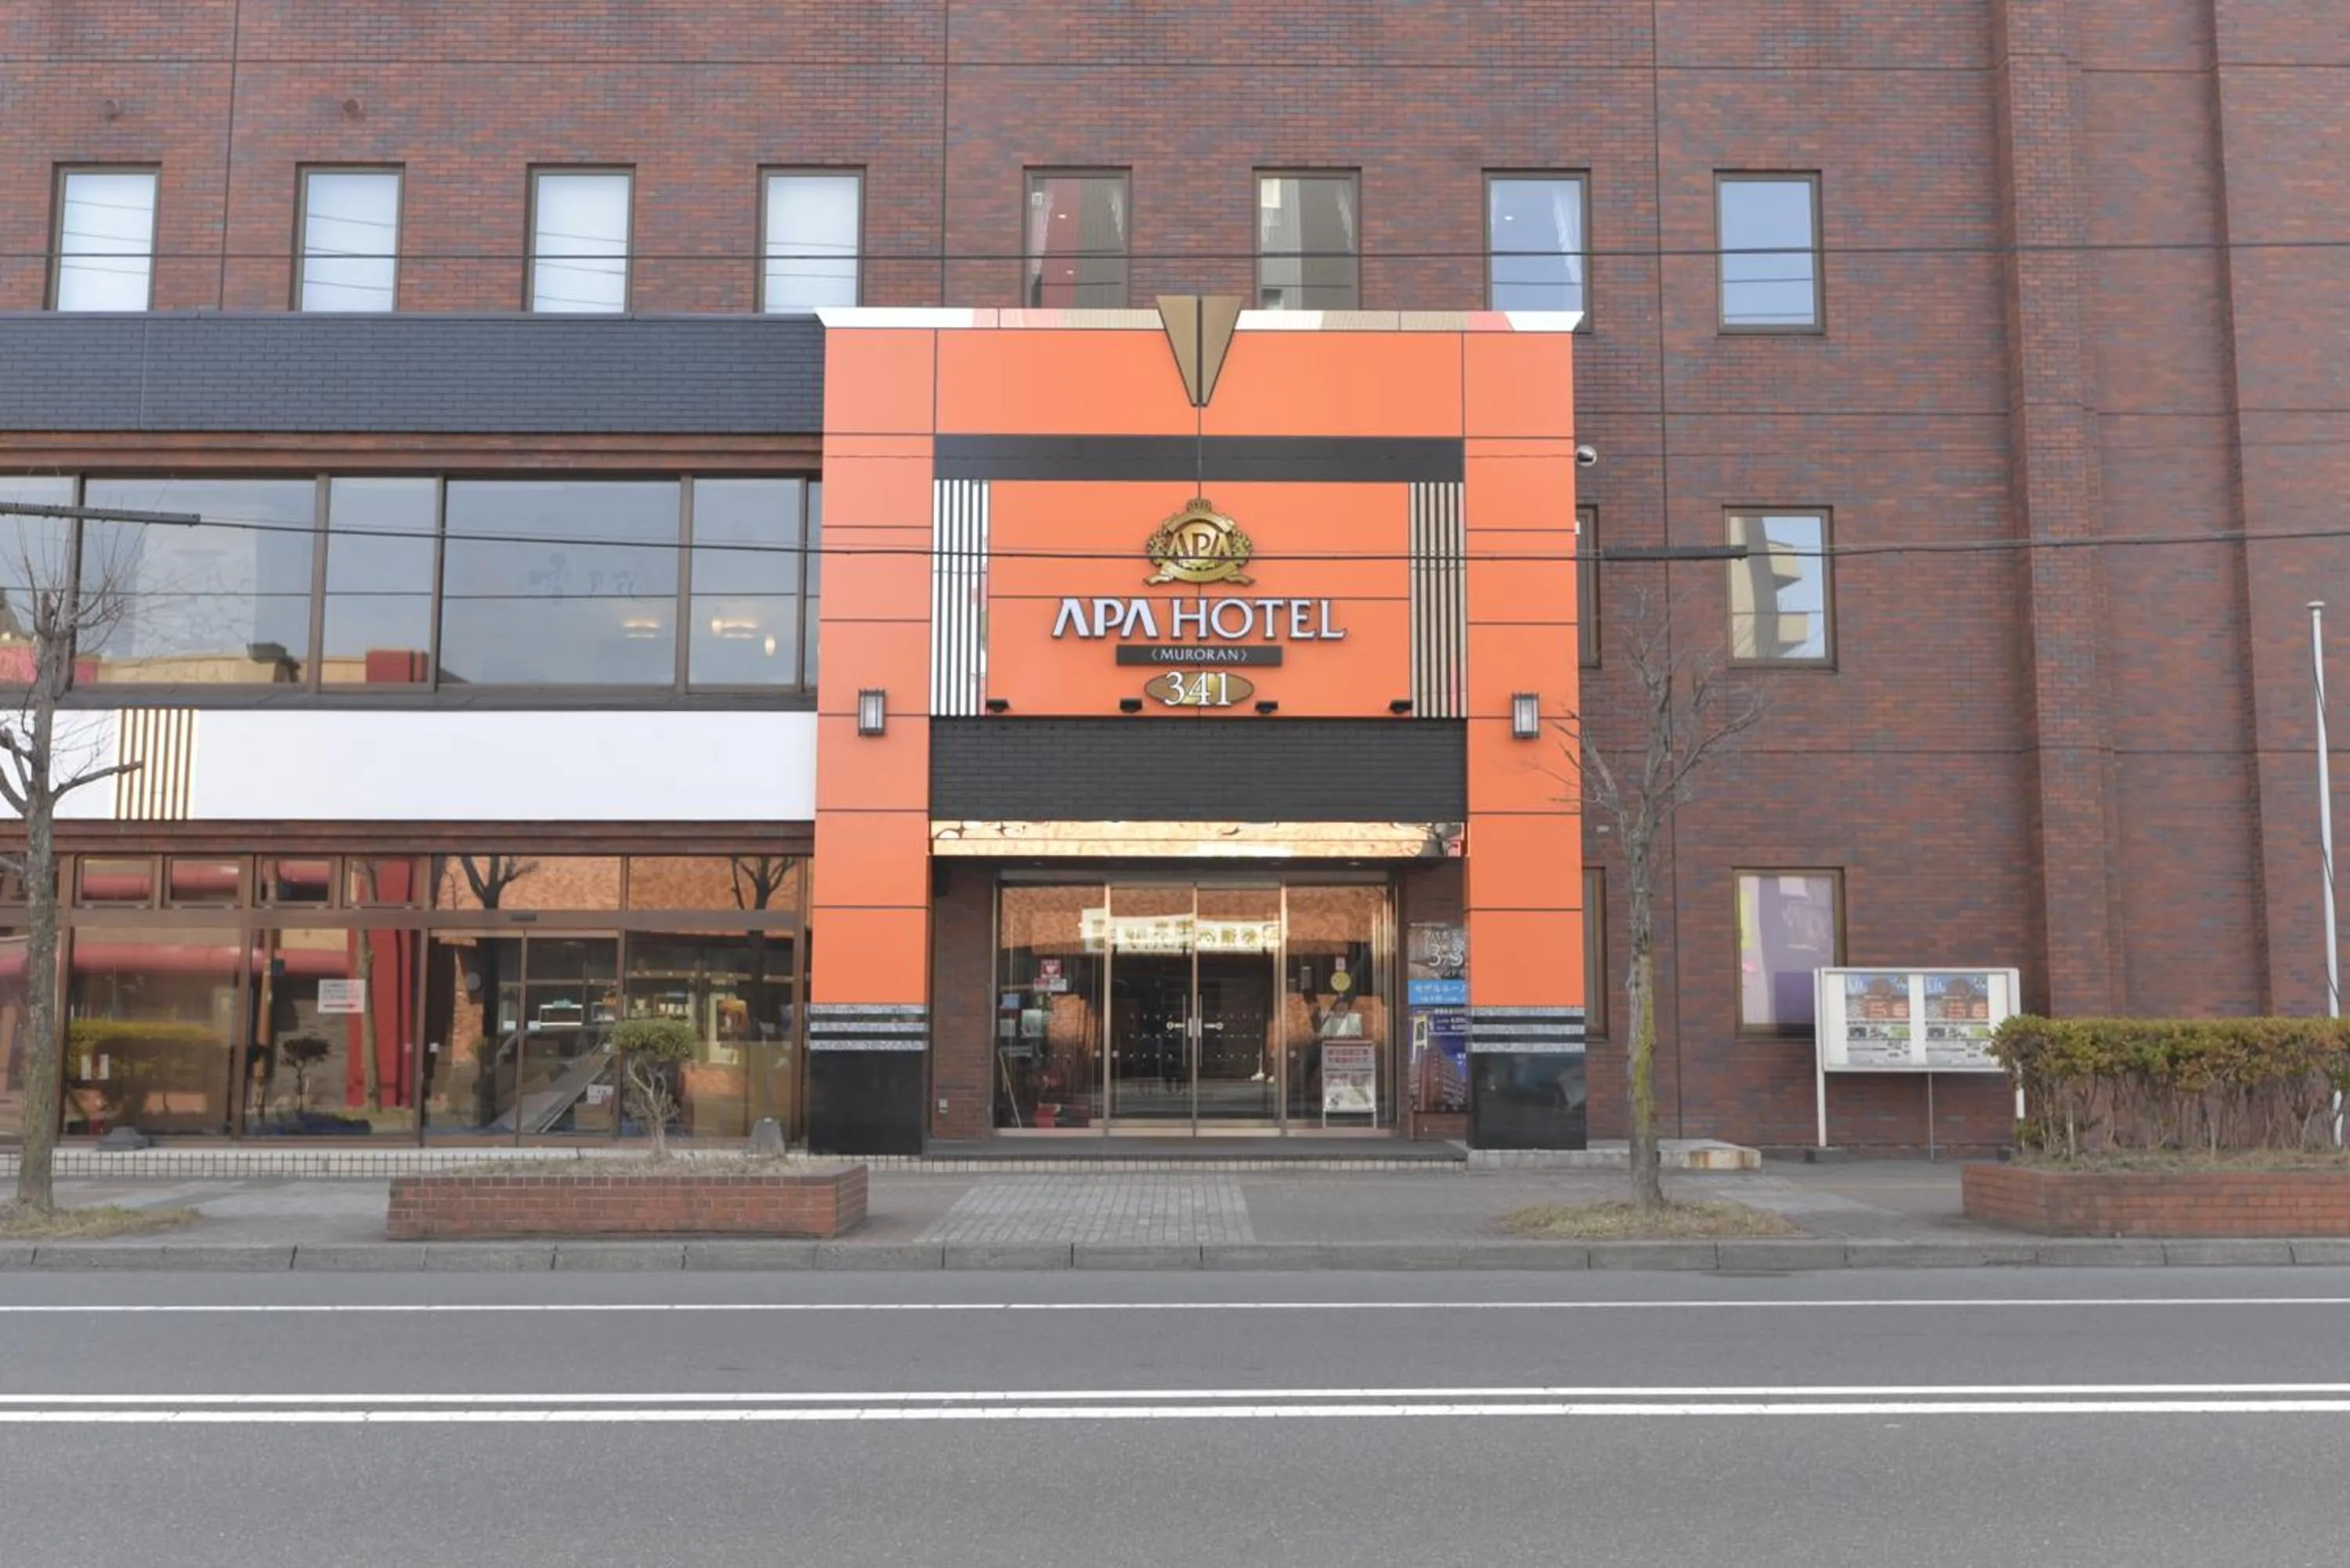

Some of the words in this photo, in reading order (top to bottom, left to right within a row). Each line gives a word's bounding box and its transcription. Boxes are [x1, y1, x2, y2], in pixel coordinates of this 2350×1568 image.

[1166, 532, 1234, 560] APA
[1051, 598, 1159, 639] APA
[1170, 598, 1348, 640] HOTEL
[1164, 671, 1231, 706] 341
